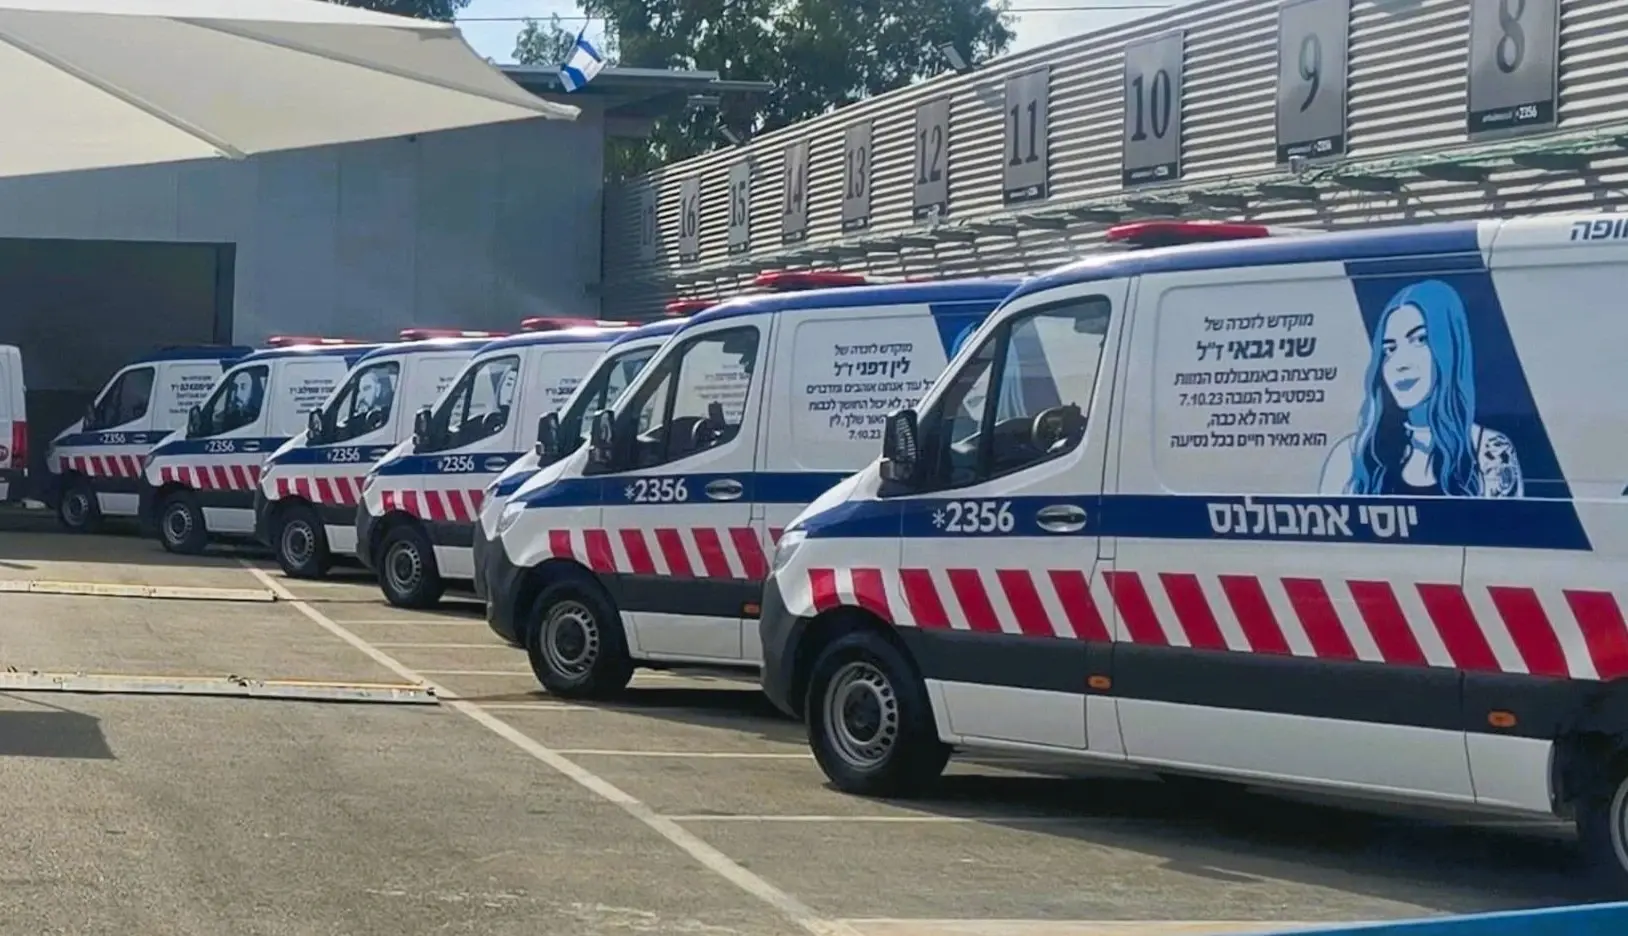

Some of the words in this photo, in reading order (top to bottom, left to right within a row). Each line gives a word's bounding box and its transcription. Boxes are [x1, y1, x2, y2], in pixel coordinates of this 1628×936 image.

[1496, 0, 1525, 74] 8
[1299, 33, 1321, 114] 9
[1131, 69, 1171, 142] 10
[1009, 98, 1039, 167] 11
[917, 124, 942, 185] 12
[846, 146, 866, 200] 13
[785, 163, 803, 216] 14
[731, 180, 746, 227] 15
[681, 194, 696, 238] 16
[1571, 219, 1628, 241] ופה
[1204, 316, 1224, 331] של
[1225, 312, 1265, 331] לזכרה
[1267, 312, 1315, 332] מוקדש
[834, 344, 849, 356] של
[879, 343, 913, 356] מוקדש
[1228, 339, 1275, 360] גבאי
[1279, 337, 1317, 358] שני
[856, 360, 888, 376] דפני
[890, 356, 911, 378] לין
[1214, 367, 1279, 384] באמבולנס
[1281, 366, 1338, 382] שנרצחה
[844, 383, 877, 393] אוהבים
[906, 381, 921, 392] עוד
[888, 396, 901, 408] לא
[1179, 393, 1223, 406] 7.10.23
[1264, 387, 1326, 404] בפסטיבל
[1207, 413, 1236, 427] כבה,
[1238, 408, 1257, 426] לא
[1258, 411, 1292, 424] אורה
[848, 429, 881, 440] 7.10.23
[1171, 435, 1209, 448] נסיעה
[1211, 431, 1234, 447] בכל
[1238, 434, 1265, 447] חיים
[1267, 433, 1301, 447] מאיר
[1303, 432, 1327, 446] הוא
[1206, 497, 1354, 537] אמבולנס
[1358, 505, 1419, 538] יוסי
